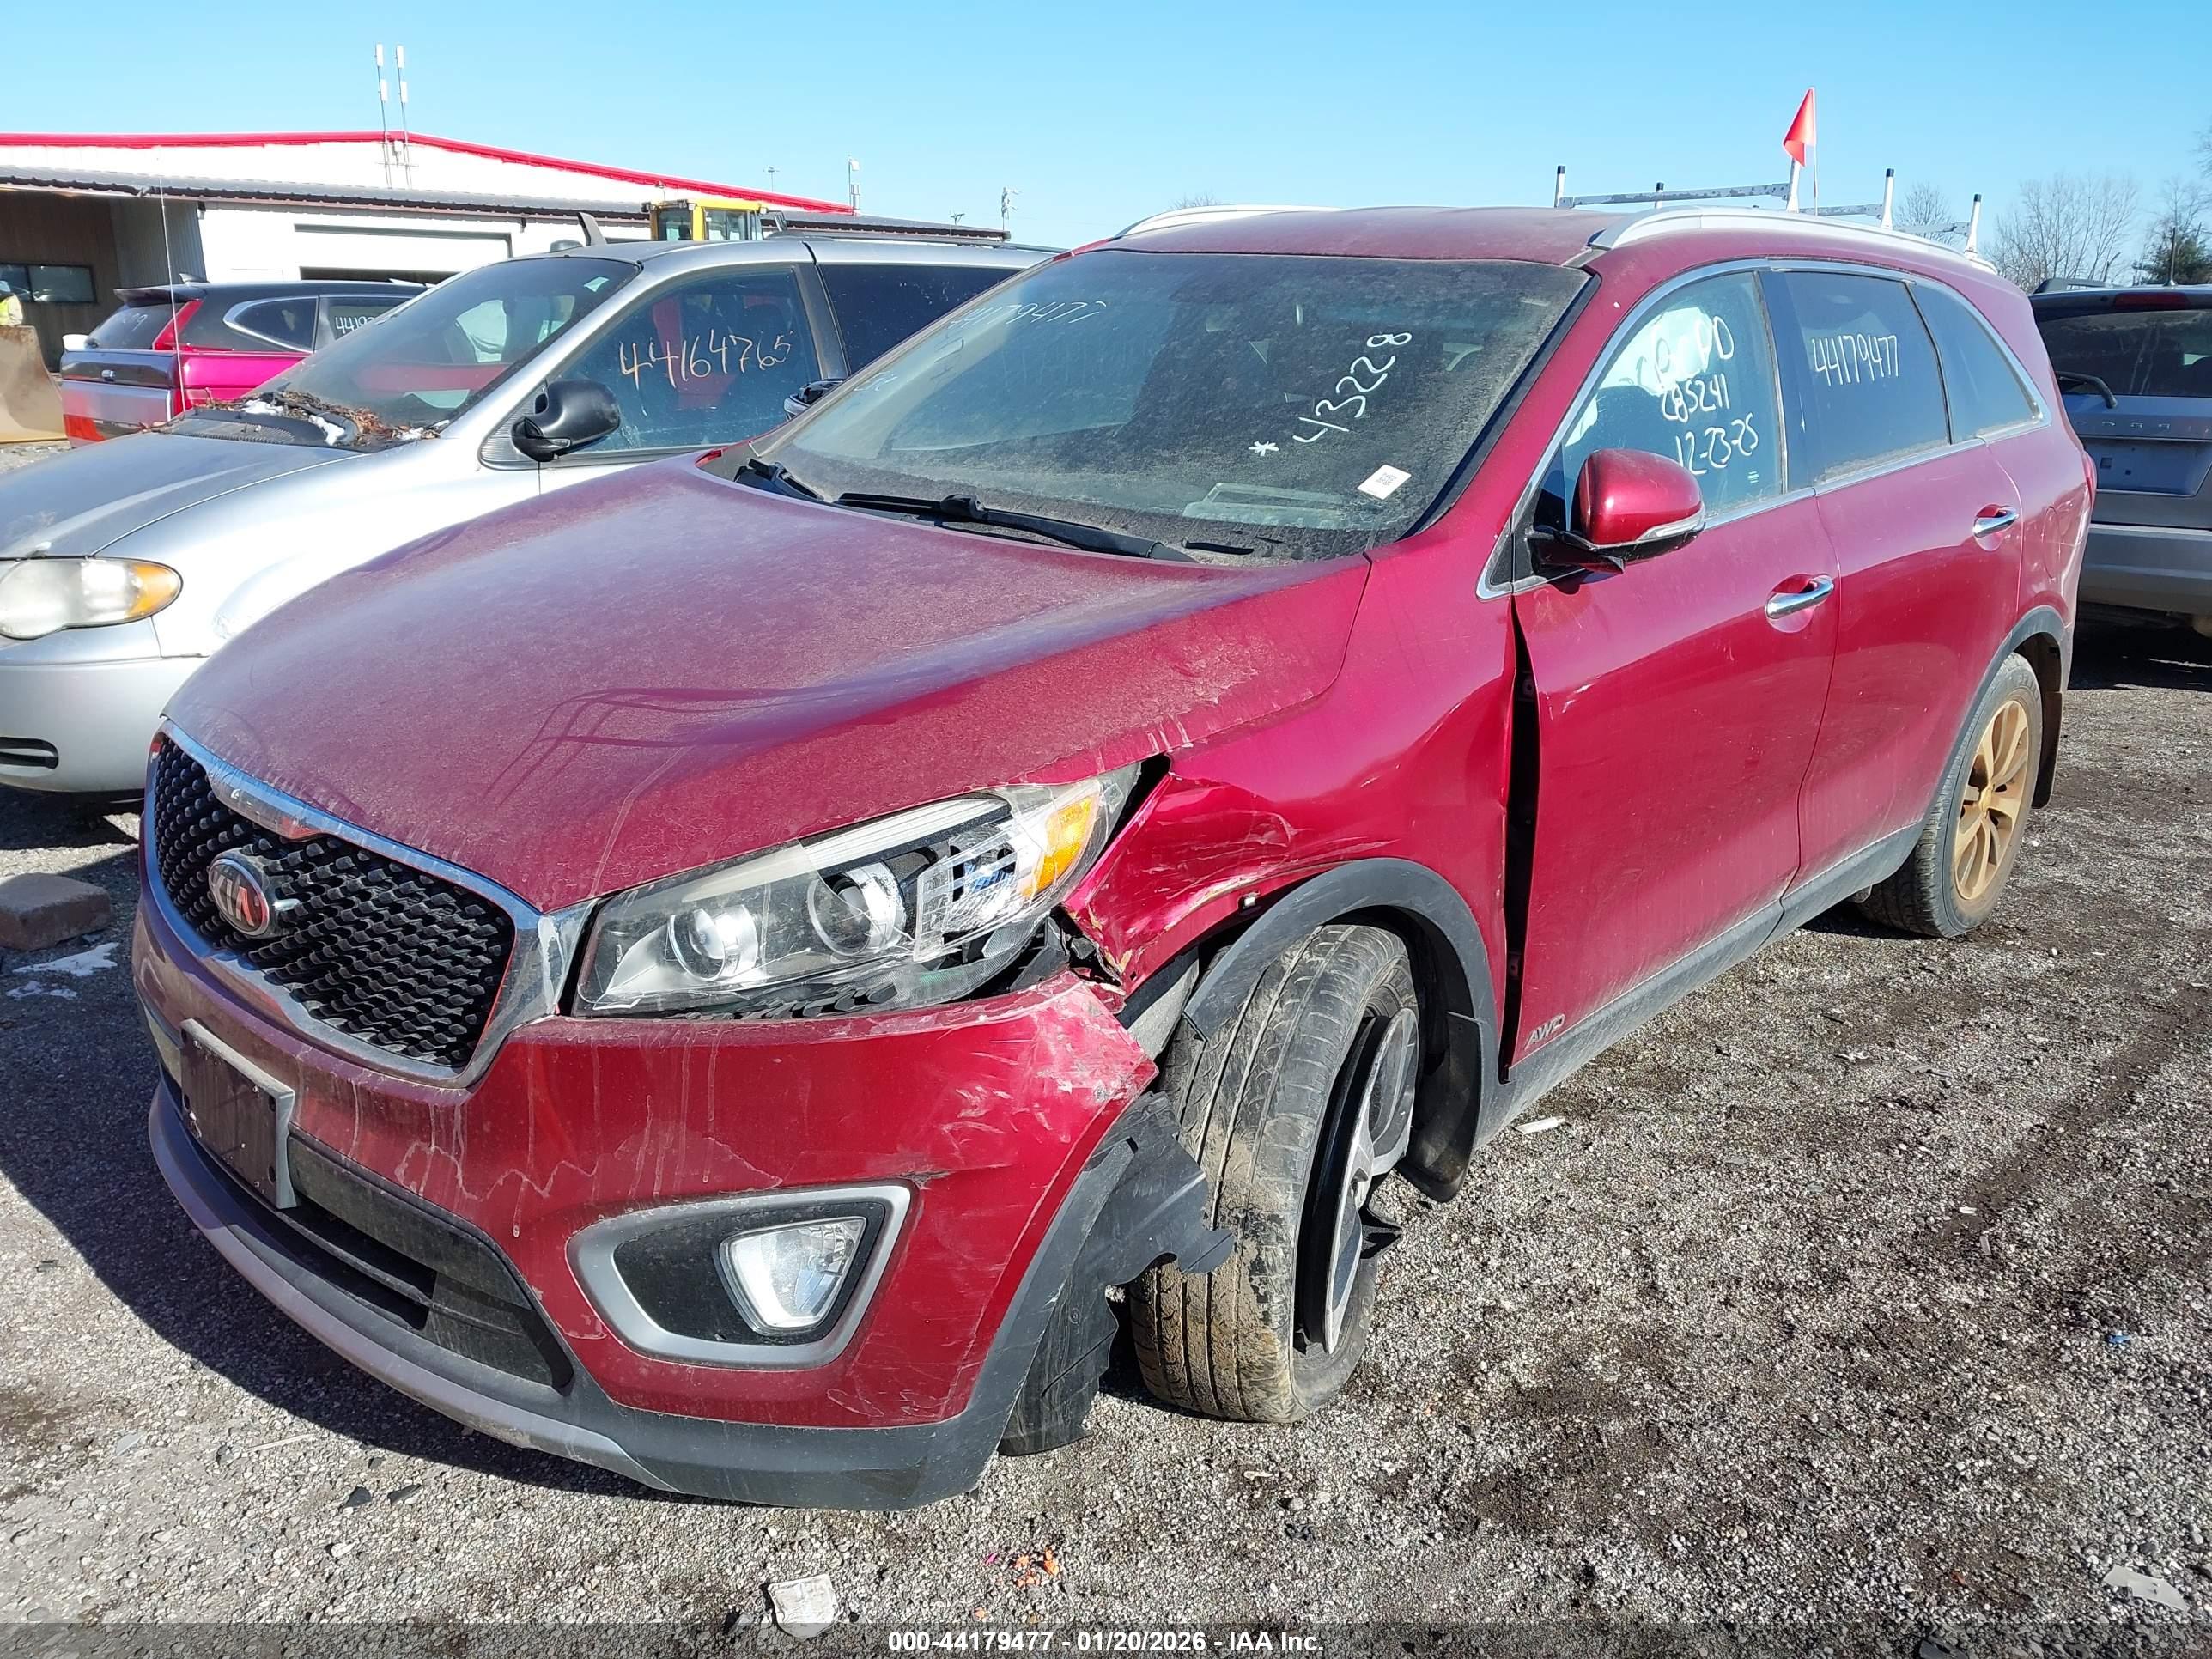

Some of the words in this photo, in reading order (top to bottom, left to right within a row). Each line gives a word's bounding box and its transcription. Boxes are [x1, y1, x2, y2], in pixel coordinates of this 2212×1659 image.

[619, 329, 794, 390] 44164765
[1812, 333, 1899, 386] 44179477
[210, 869, 255, 927] KIA
[1523, 1013, 1565, 1051] AWD
